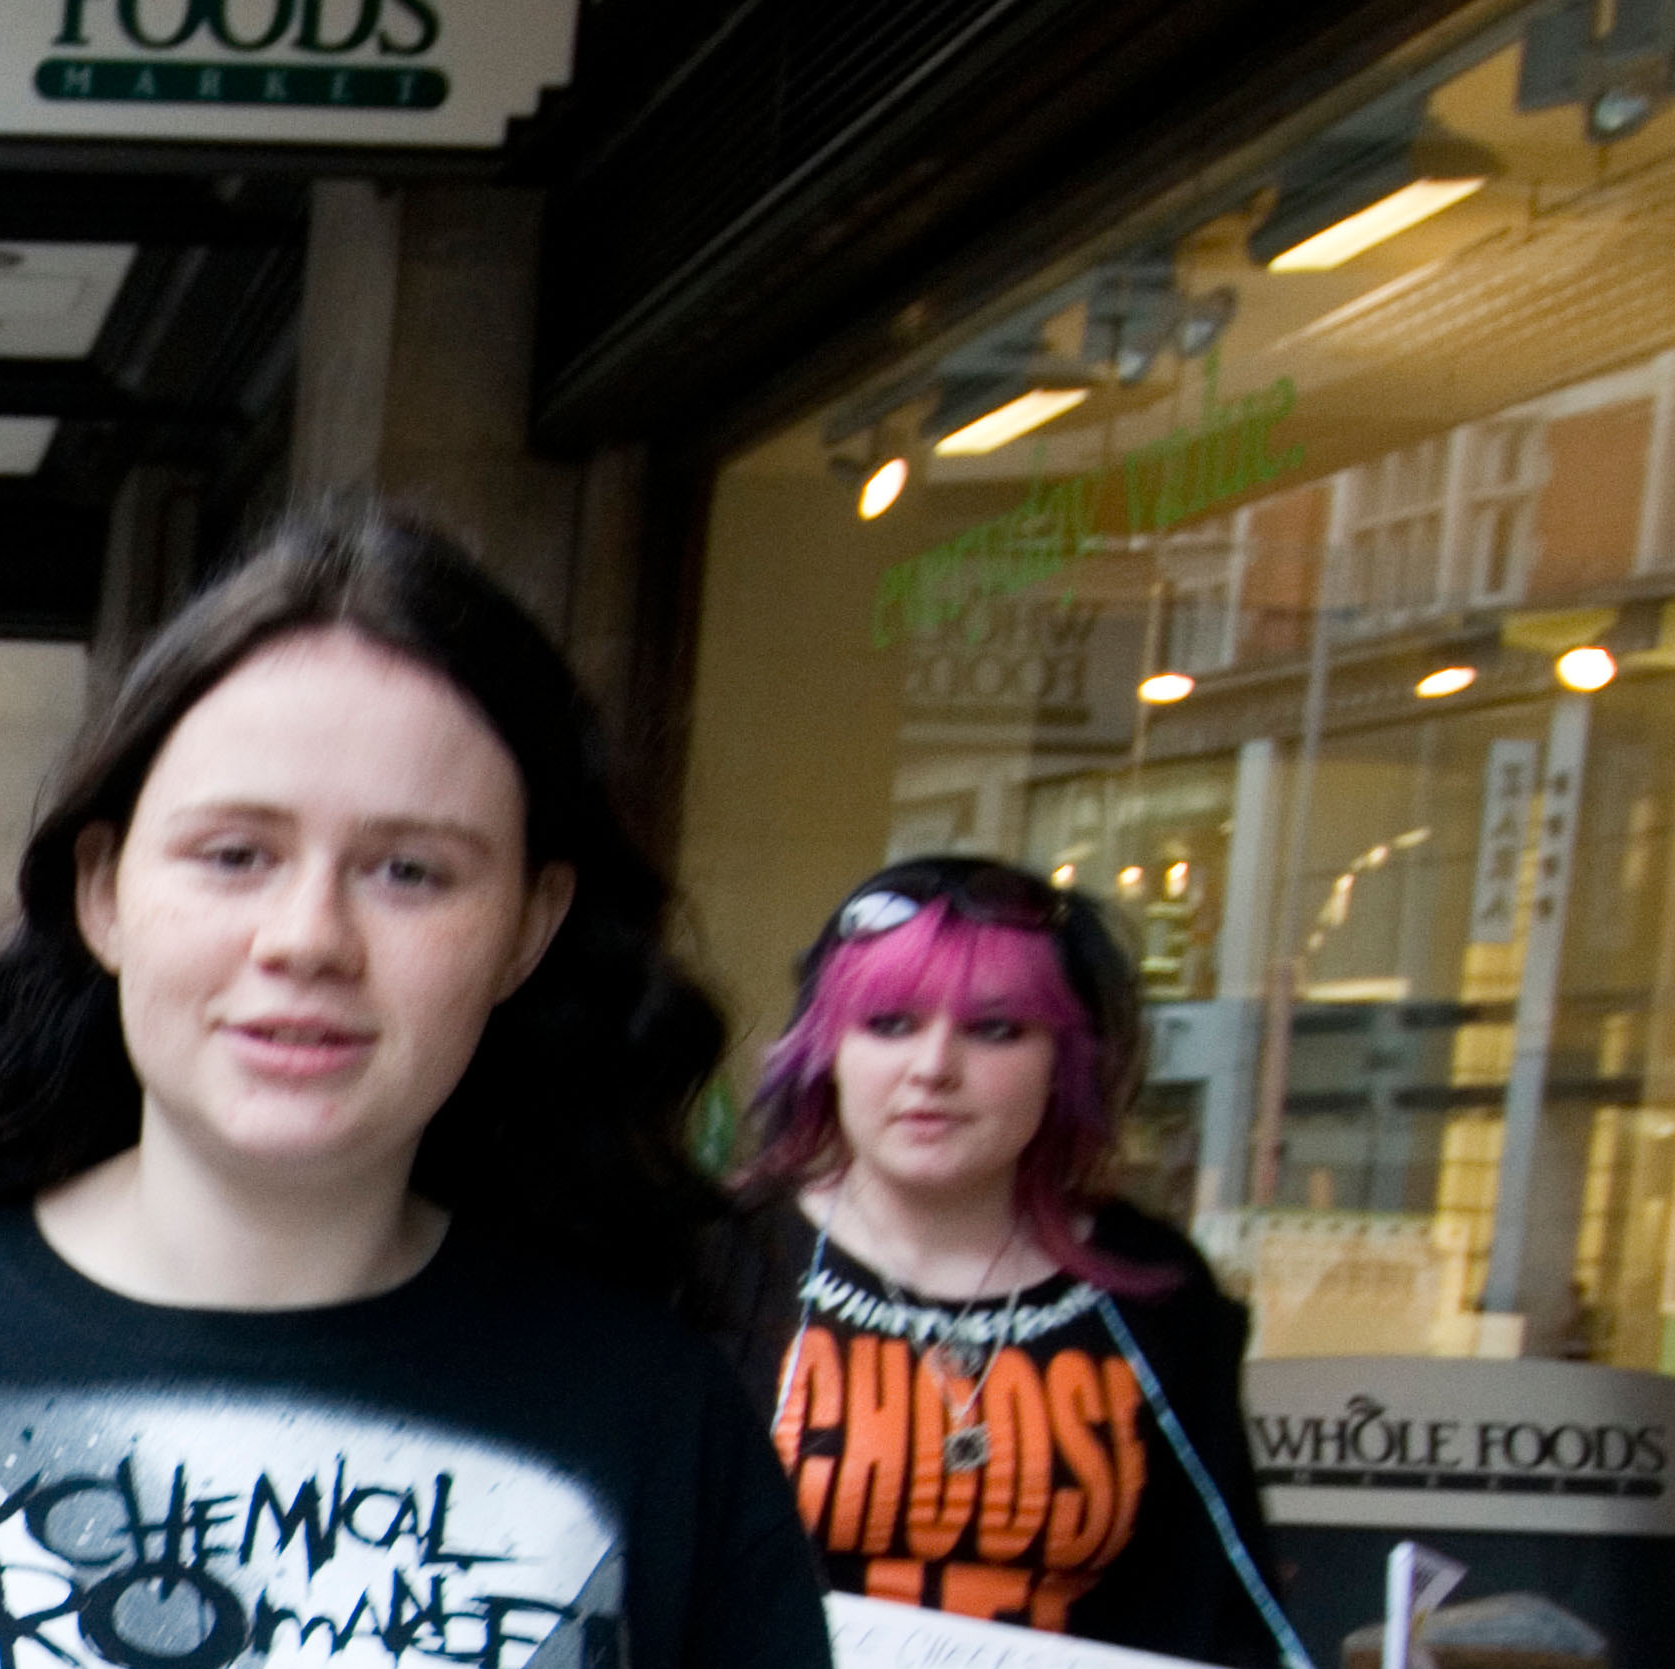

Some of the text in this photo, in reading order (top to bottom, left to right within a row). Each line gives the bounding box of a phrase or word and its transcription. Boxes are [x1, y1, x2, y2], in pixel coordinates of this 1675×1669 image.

[62, 65, 416, 103] MARKET
[1251, 1404, 1666, 1474] WHOLE FOODS
[28, 1445, 535, 1590] CHEMICAL
